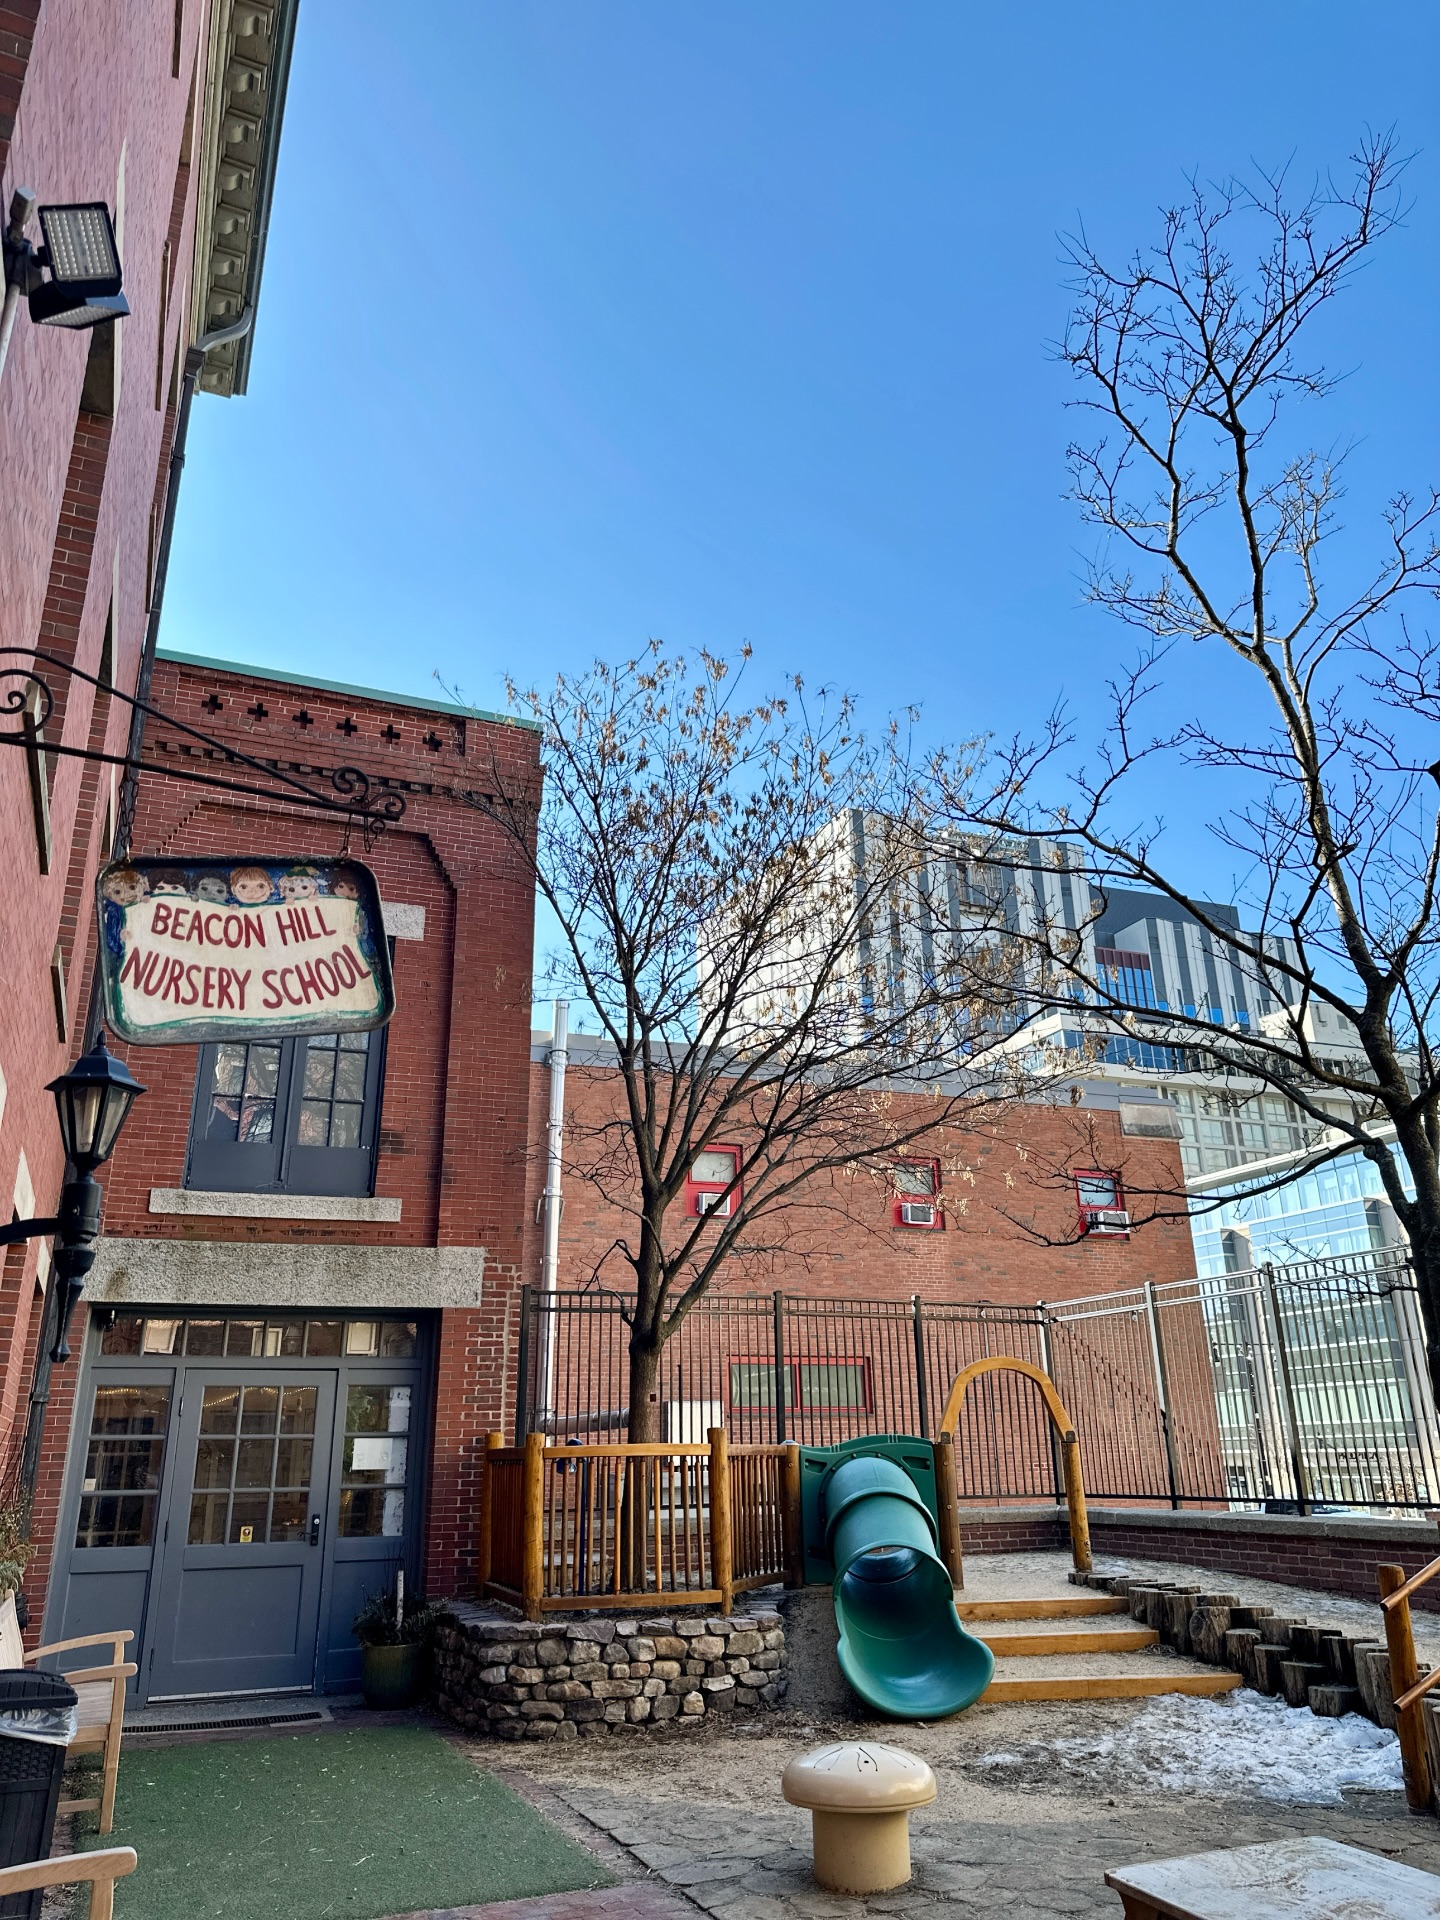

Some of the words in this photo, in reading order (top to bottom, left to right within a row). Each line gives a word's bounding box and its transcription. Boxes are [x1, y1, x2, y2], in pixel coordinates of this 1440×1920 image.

[150, 902, 266, 949] BEACON
[275, 905, 337, 946] HILL
[120, 946, 251, 1011] NURSERY
[262, 944, 372, 1009] SCHOOL
